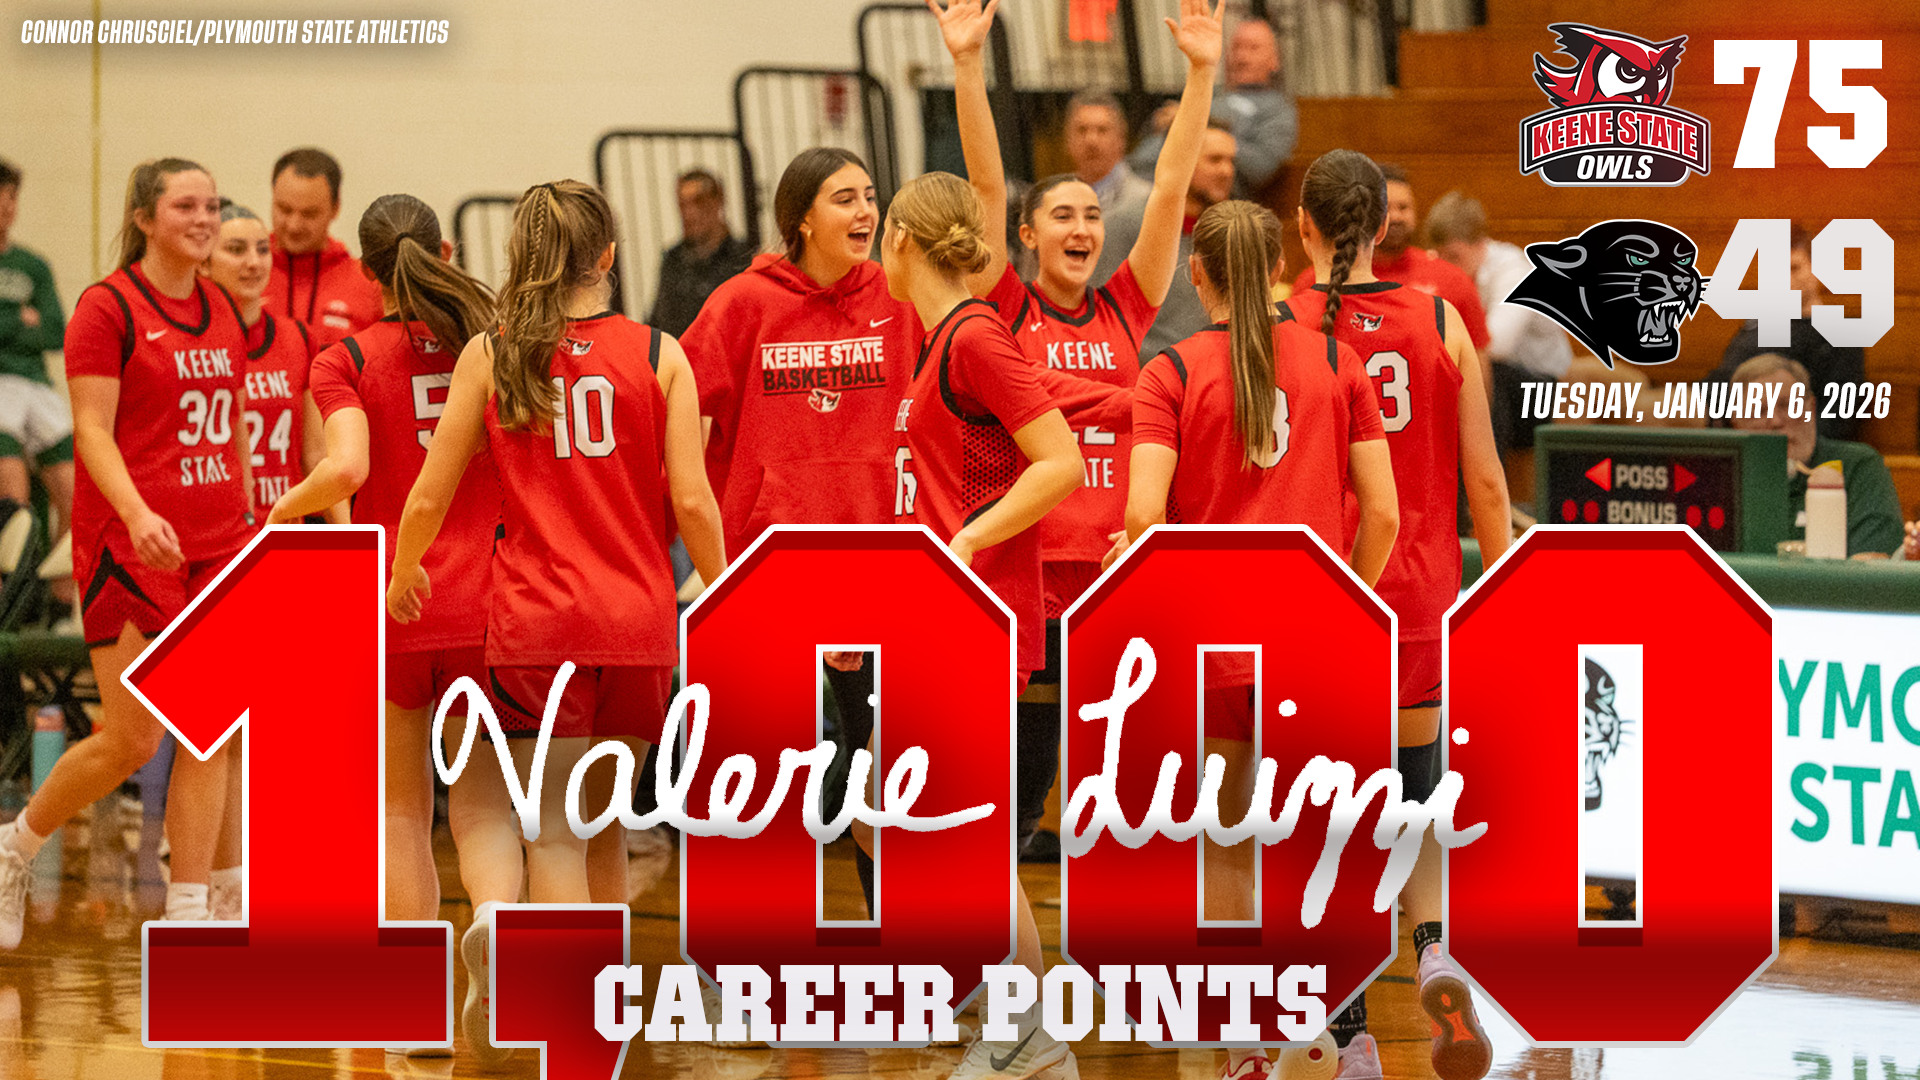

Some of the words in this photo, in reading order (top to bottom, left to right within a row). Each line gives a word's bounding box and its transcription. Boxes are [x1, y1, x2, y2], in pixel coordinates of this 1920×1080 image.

[174, 348, 234, 379] KEENE
[761, 346, 826, 370] KEENE
[830, 341, 884, 366] STATE
[1046, 341, 1117, 370] KEENE
[245, 370, 293, 400] EENE
[763, 363, 886, 391] BASKETBALL
[177, 388, 233, 446] 30
[550, 375, 616, 459] 10
[244, 409, 292, 466] 24
[1615, 464, 1669, 490] POSS
[1607, 501, 1677, 524] BONUS
